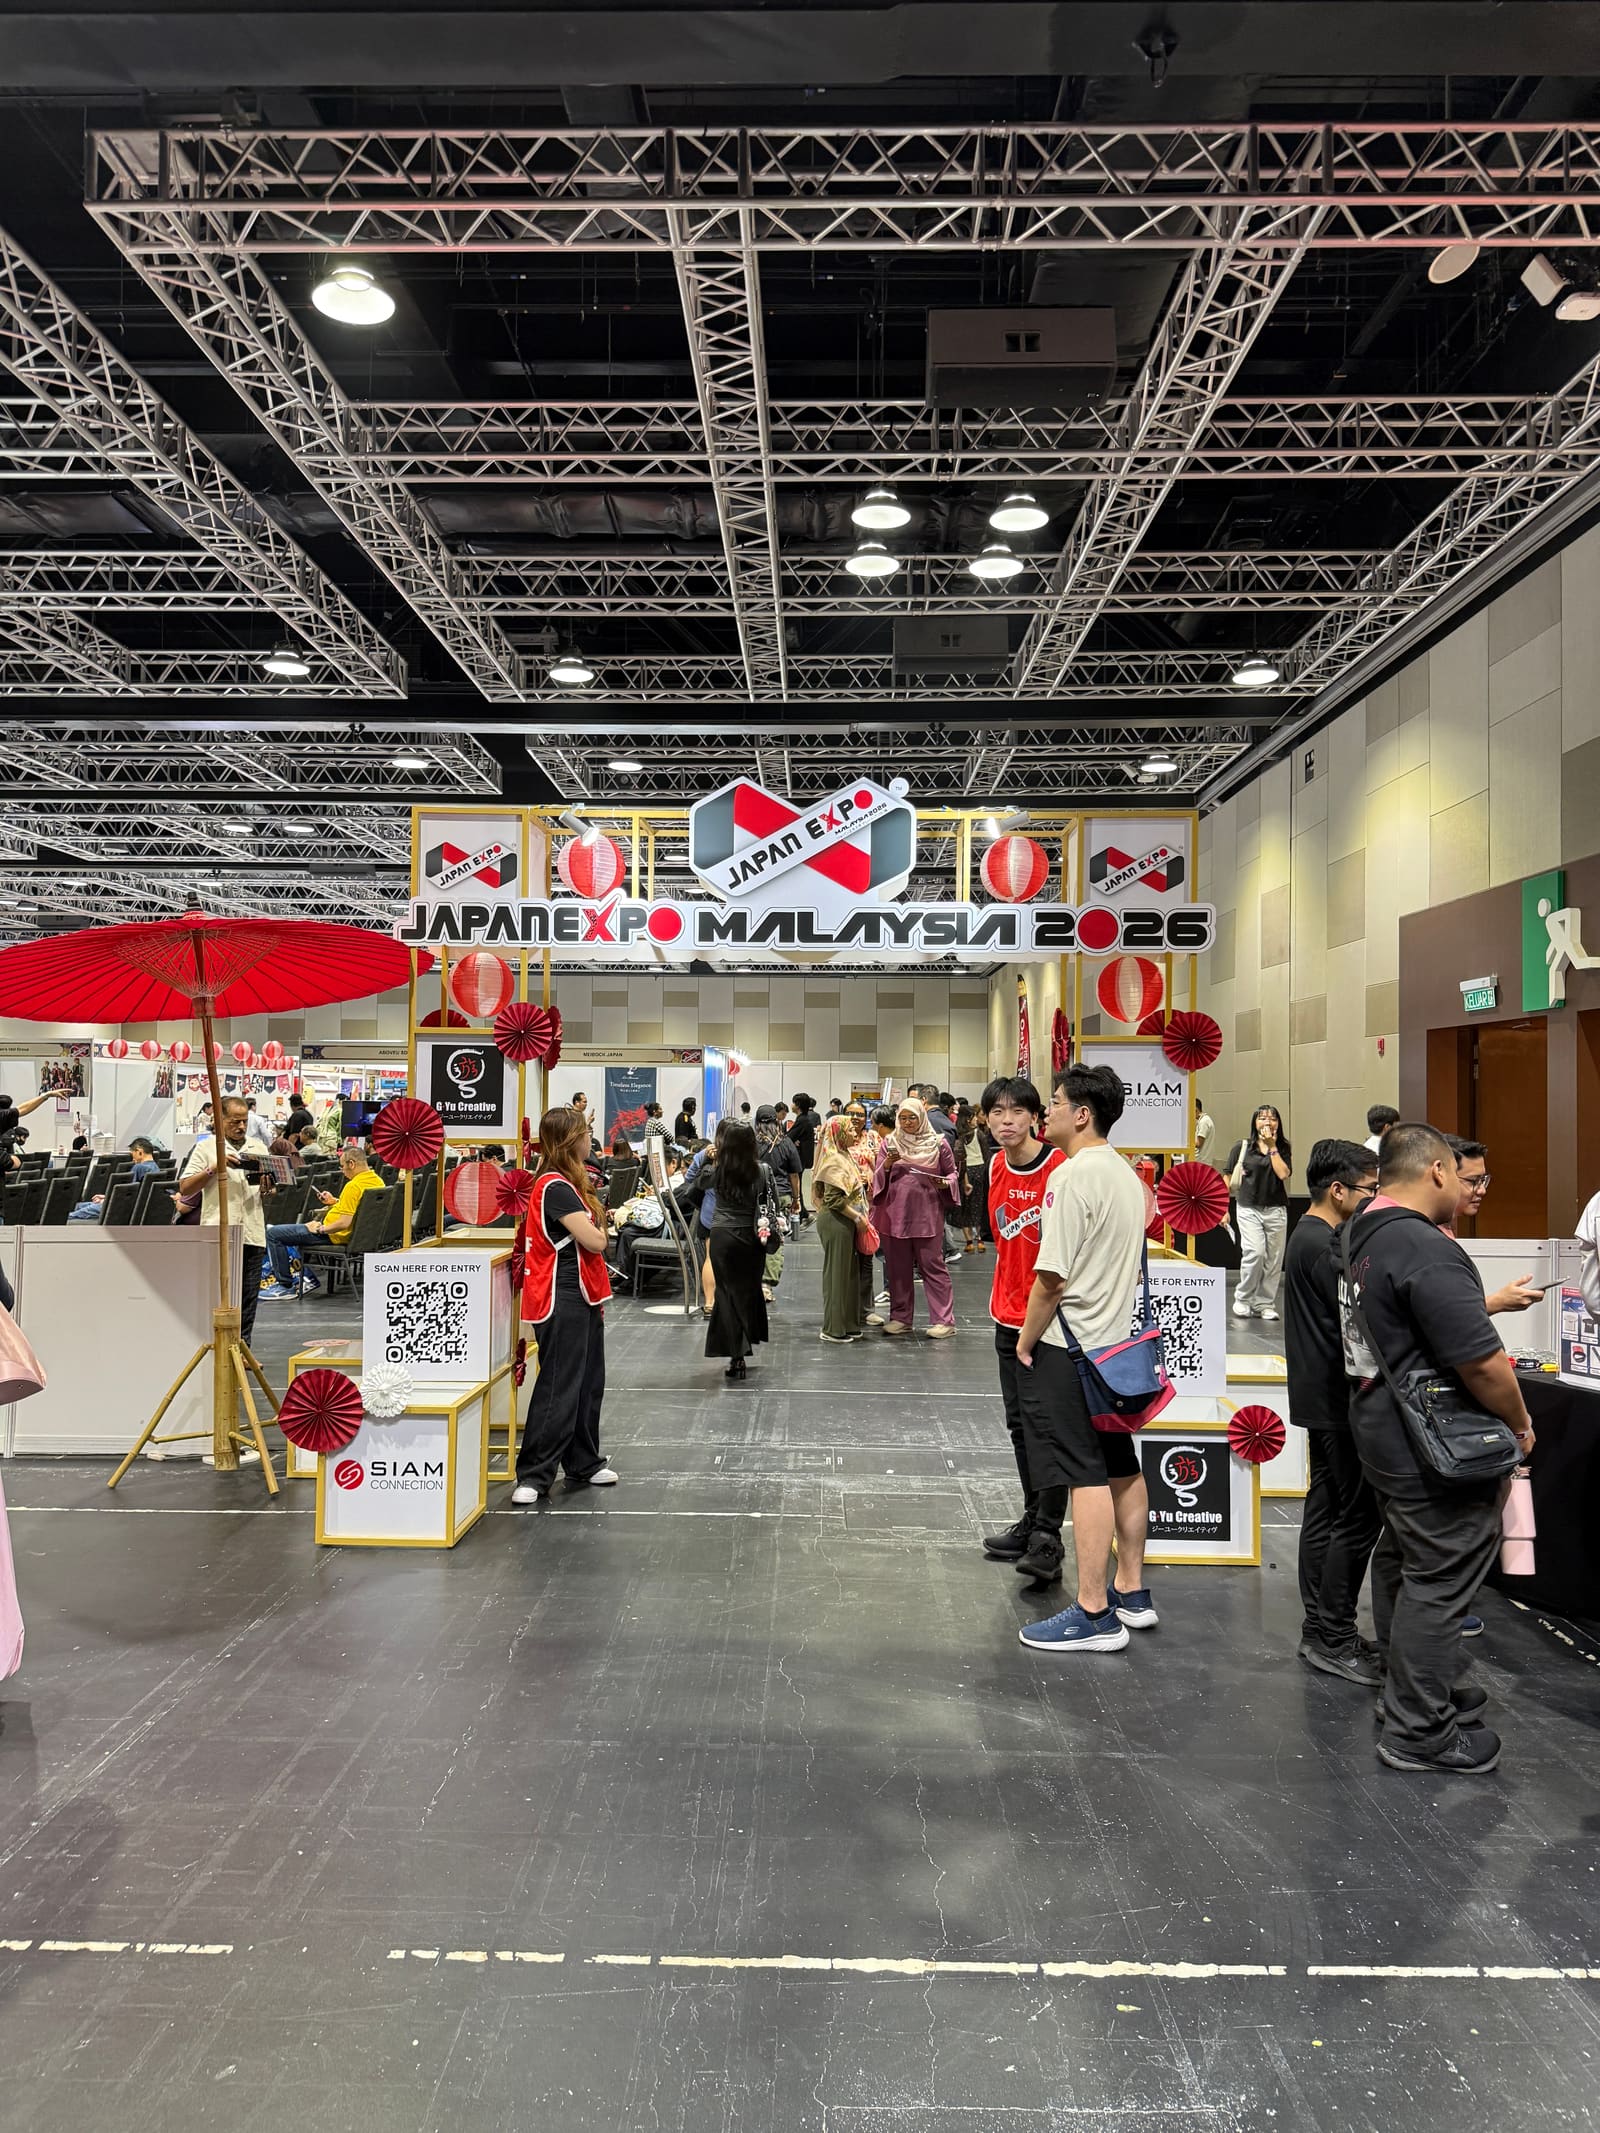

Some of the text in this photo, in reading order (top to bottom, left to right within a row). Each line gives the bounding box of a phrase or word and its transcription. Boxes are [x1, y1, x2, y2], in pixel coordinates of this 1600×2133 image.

[728, 832, 803, 889] JAPAN
[805, 790, 873, 840] EXPO
[440, 862, 472, 886] JAPAN
[472, 845, 501, 866] EXPO
[1104, 867, 1137, 892] JAPAN
[1138, 848, 1168, 870] EXPO
[698, 911, 1016, 946] MALAYSIA
[1035, 909, 1208, 949] 2026
[1121, 1083, 1181, 1095] SIAM
[458, 1101, 496, 1112] Creative
[1125, 1098, 1181, 1107] ONNECTION
[1009, 1189, 1037, 1200] STAFF
[374, 1264, 481, 1273] SCAN HERE FOR ENTRY
[1162, 1278, 1182, 1286] FOR
[1184, 1278, 1215, 1286] ENTRY
[370, 1461, 443, 1477] SIAM
[370, 1480, 443, 1490] CONNECTION
[1175, 1510, 1223, 1523] Creative
